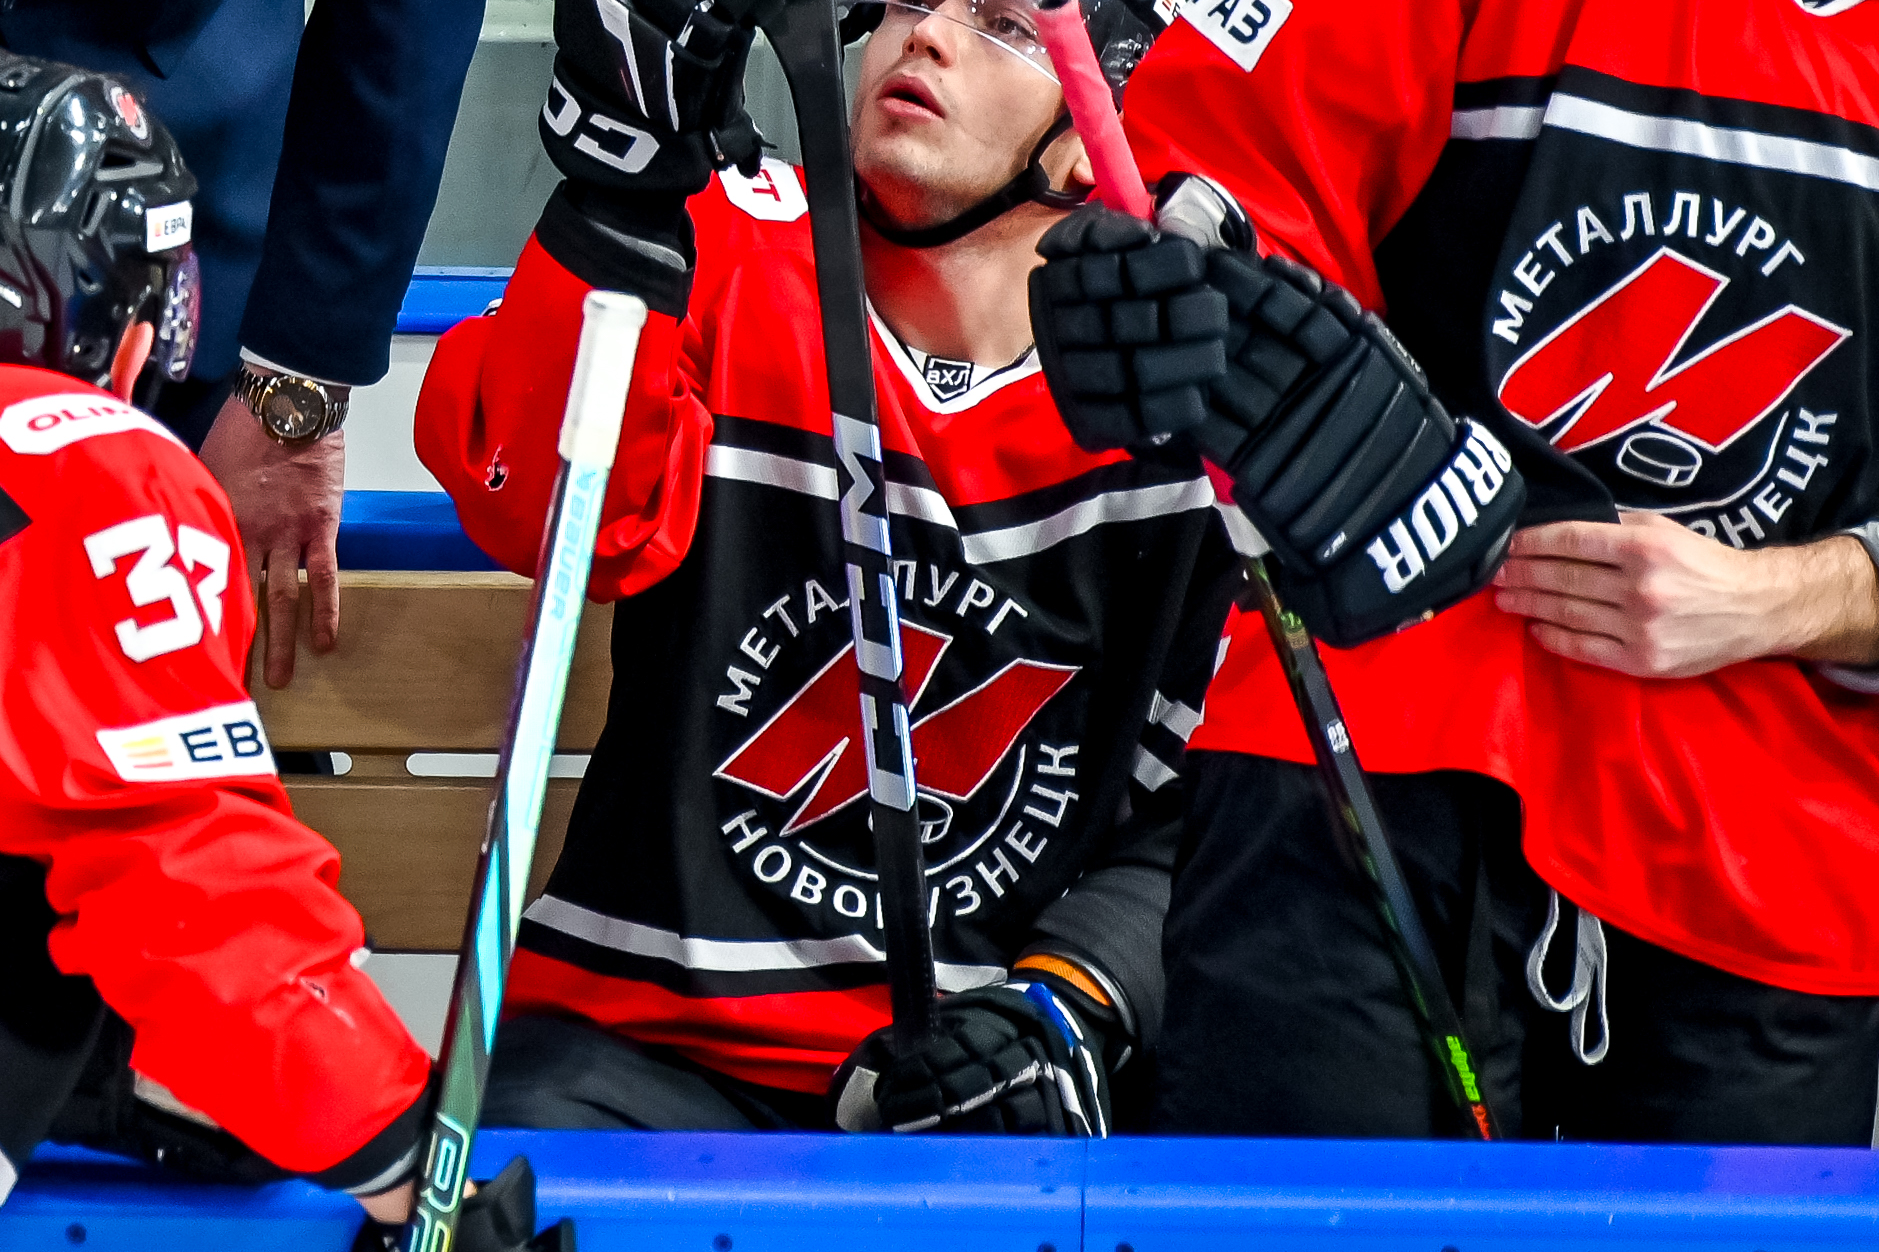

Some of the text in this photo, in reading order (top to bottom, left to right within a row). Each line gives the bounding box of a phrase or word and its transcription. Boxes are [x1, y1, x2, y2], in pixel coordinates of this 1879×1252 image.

[1492, 191, 1805, 345] МЕТАЛЛУРГ
[926, 369, 971, 386] ВХЛ
[716, 560, 1028, 717] МЕТАЛУРГ
